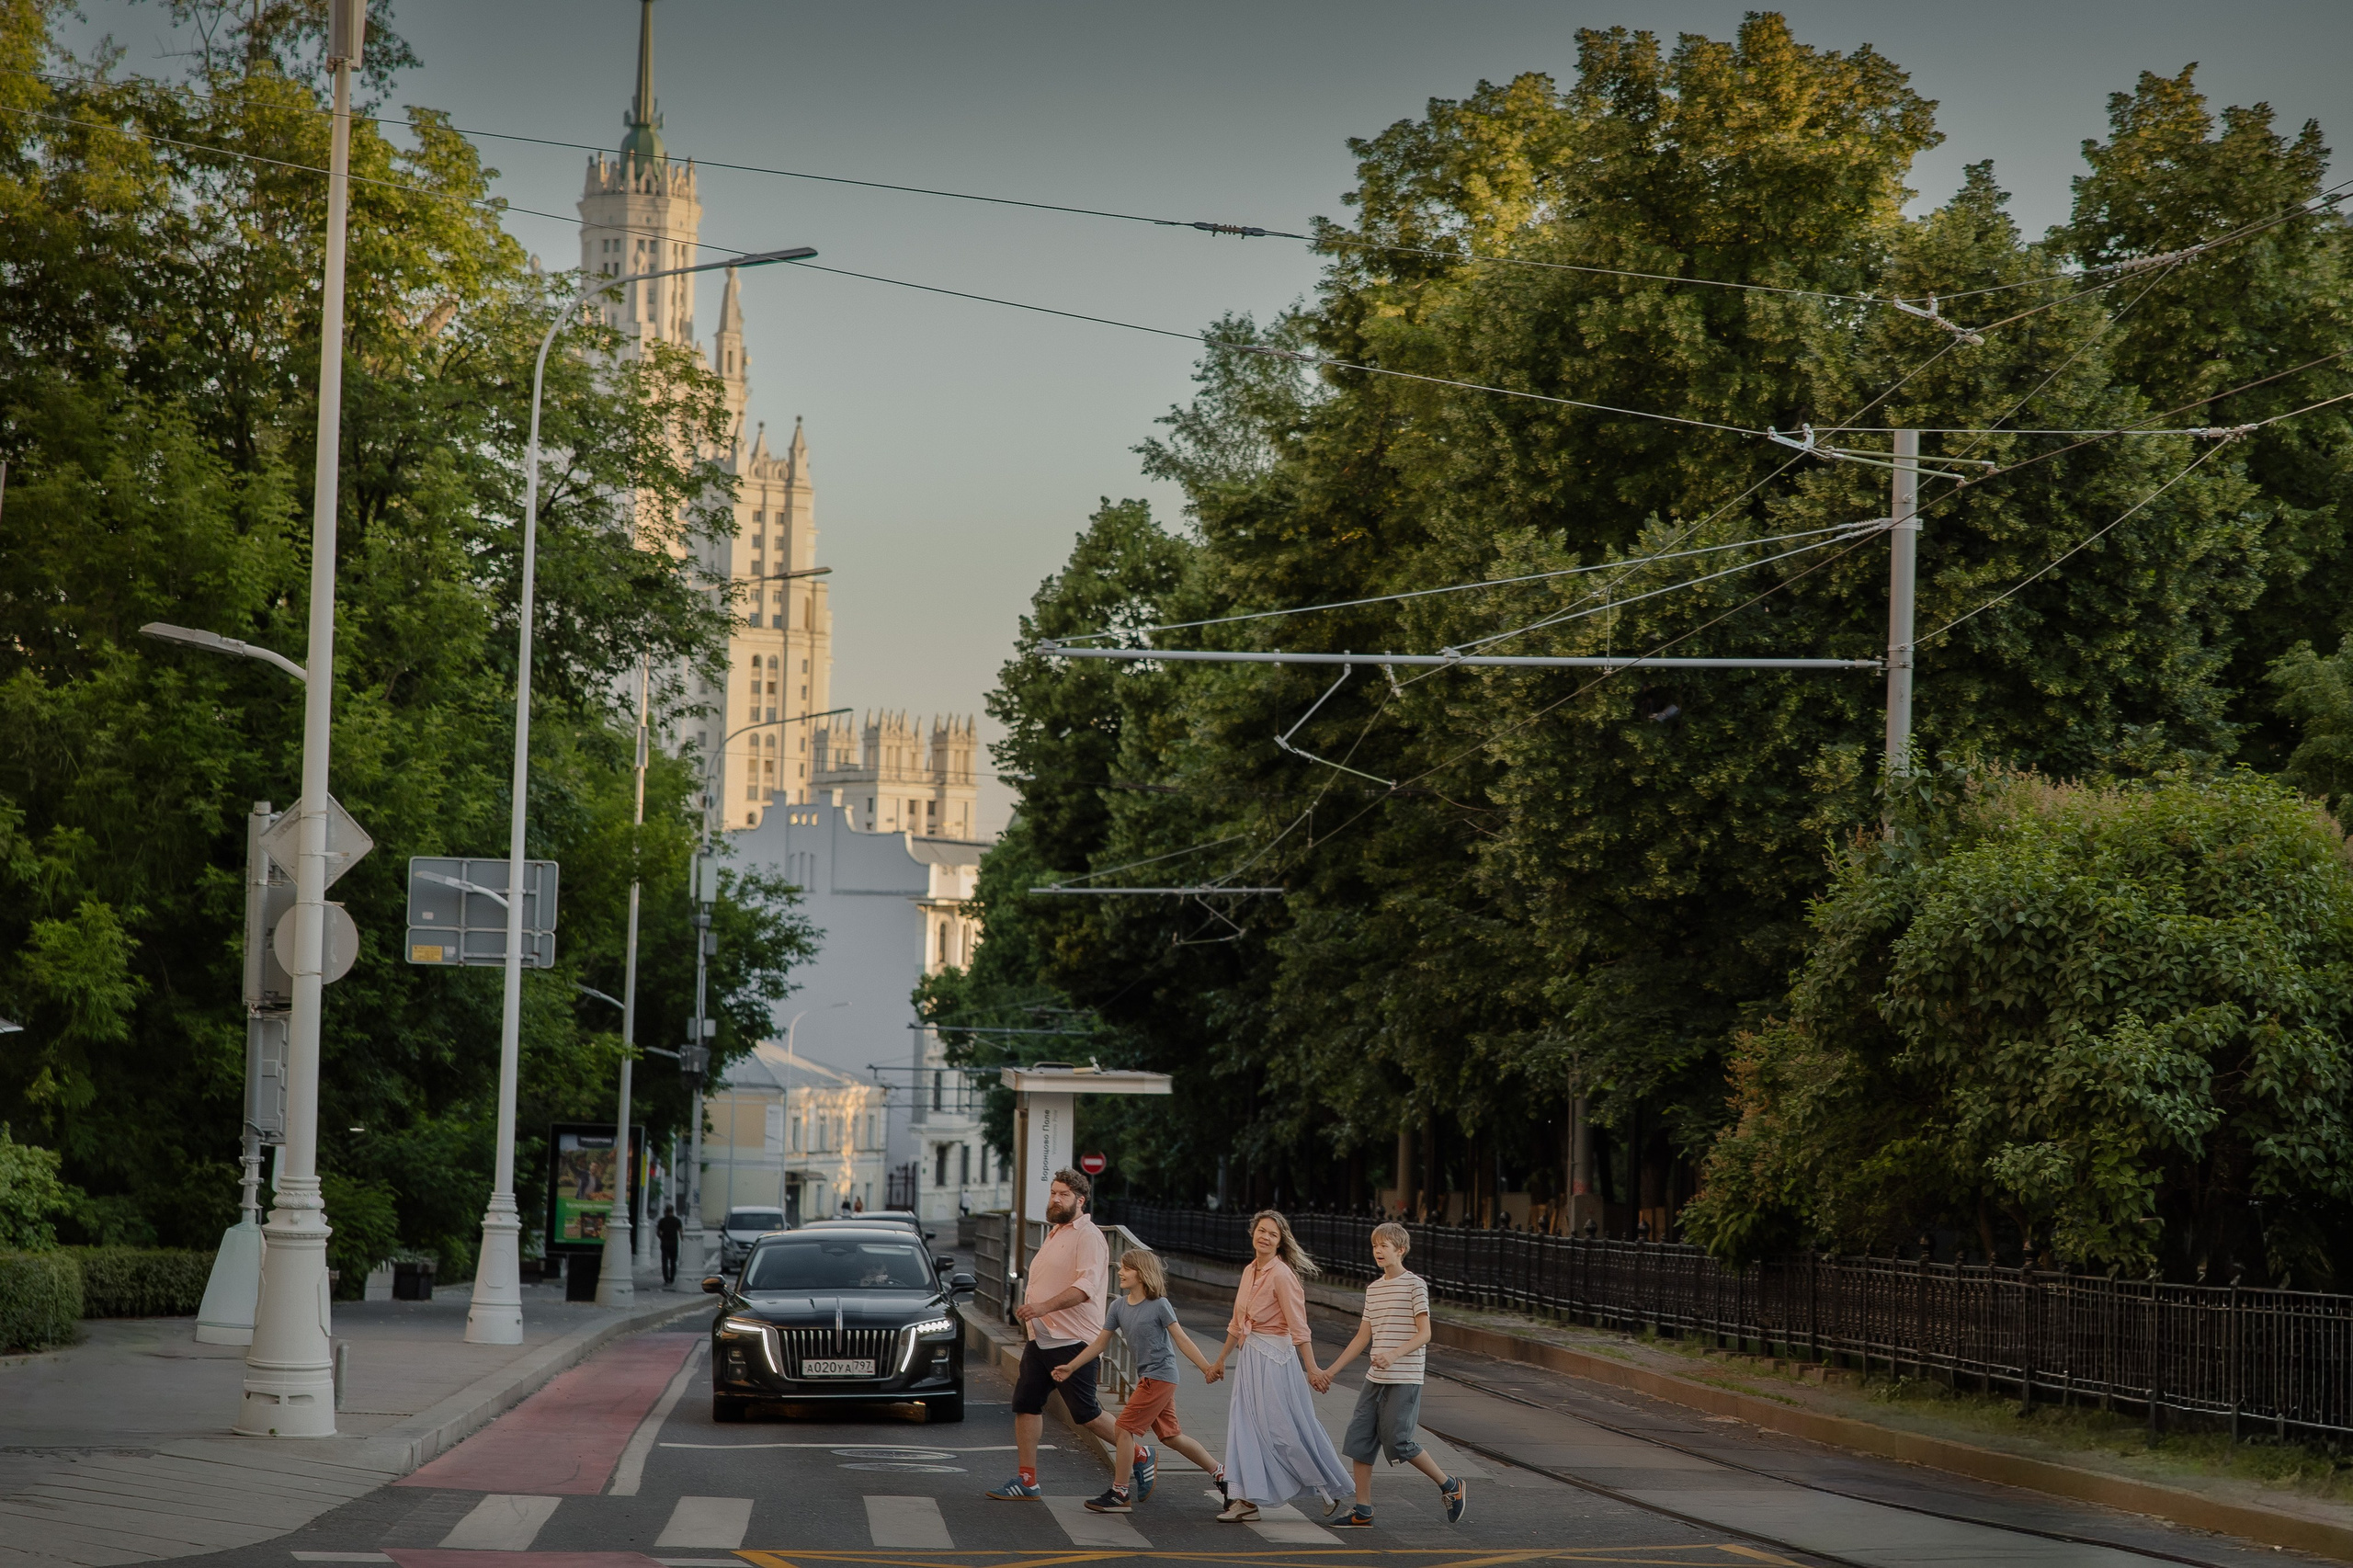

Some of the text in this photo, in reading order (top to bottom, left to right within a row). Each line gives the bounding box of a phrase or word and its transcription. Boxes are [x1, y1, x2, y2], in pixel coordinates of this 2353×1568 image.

[1040, 1109, 1051, 1182] Воронцово Поле
[853, 1361, 871, 1370] 797
